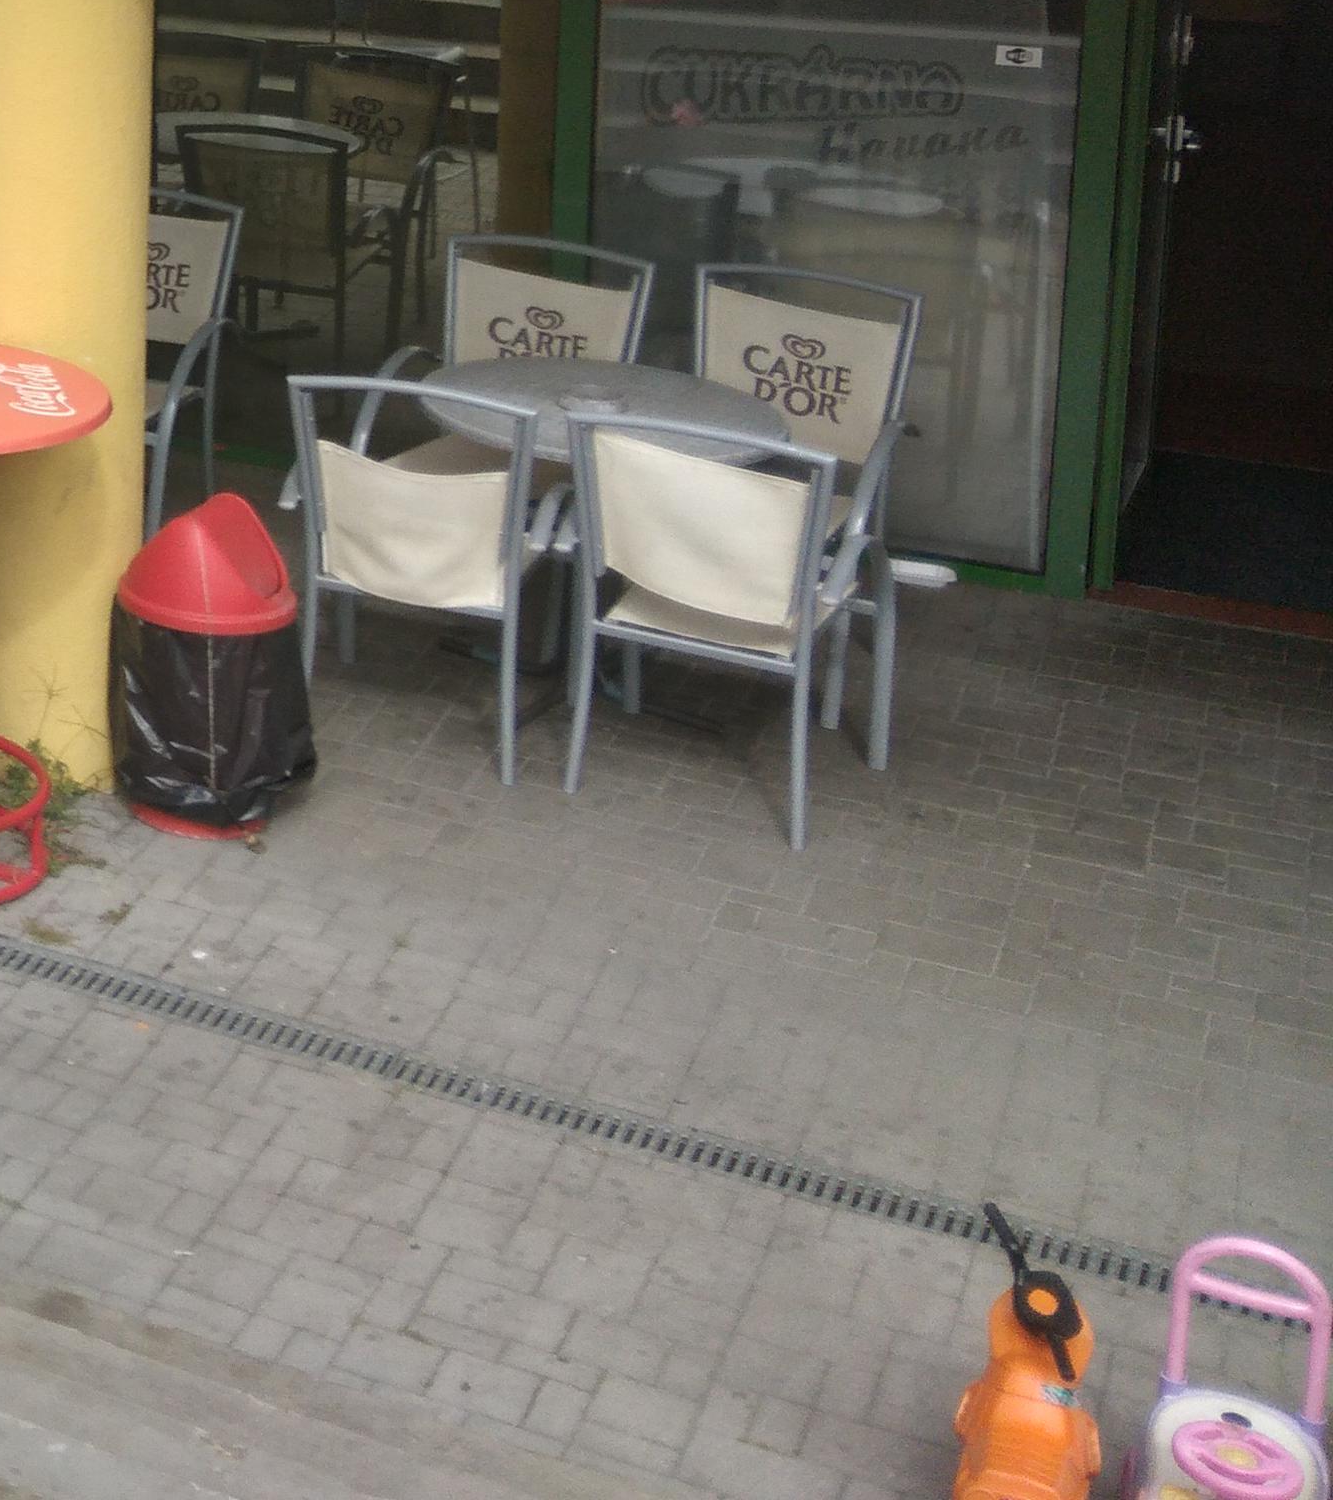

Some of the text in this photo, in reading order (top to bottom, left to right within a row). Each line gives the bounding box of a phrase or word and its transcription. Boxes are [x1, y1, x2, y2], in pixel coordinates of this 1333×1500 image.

[645, 47, 961, 123] CUKRÁRNA
[147, 263, 191, 288] RTE
[488, 317, 587, 358] CARTE
[743, 345, 852, 395] CARTE
